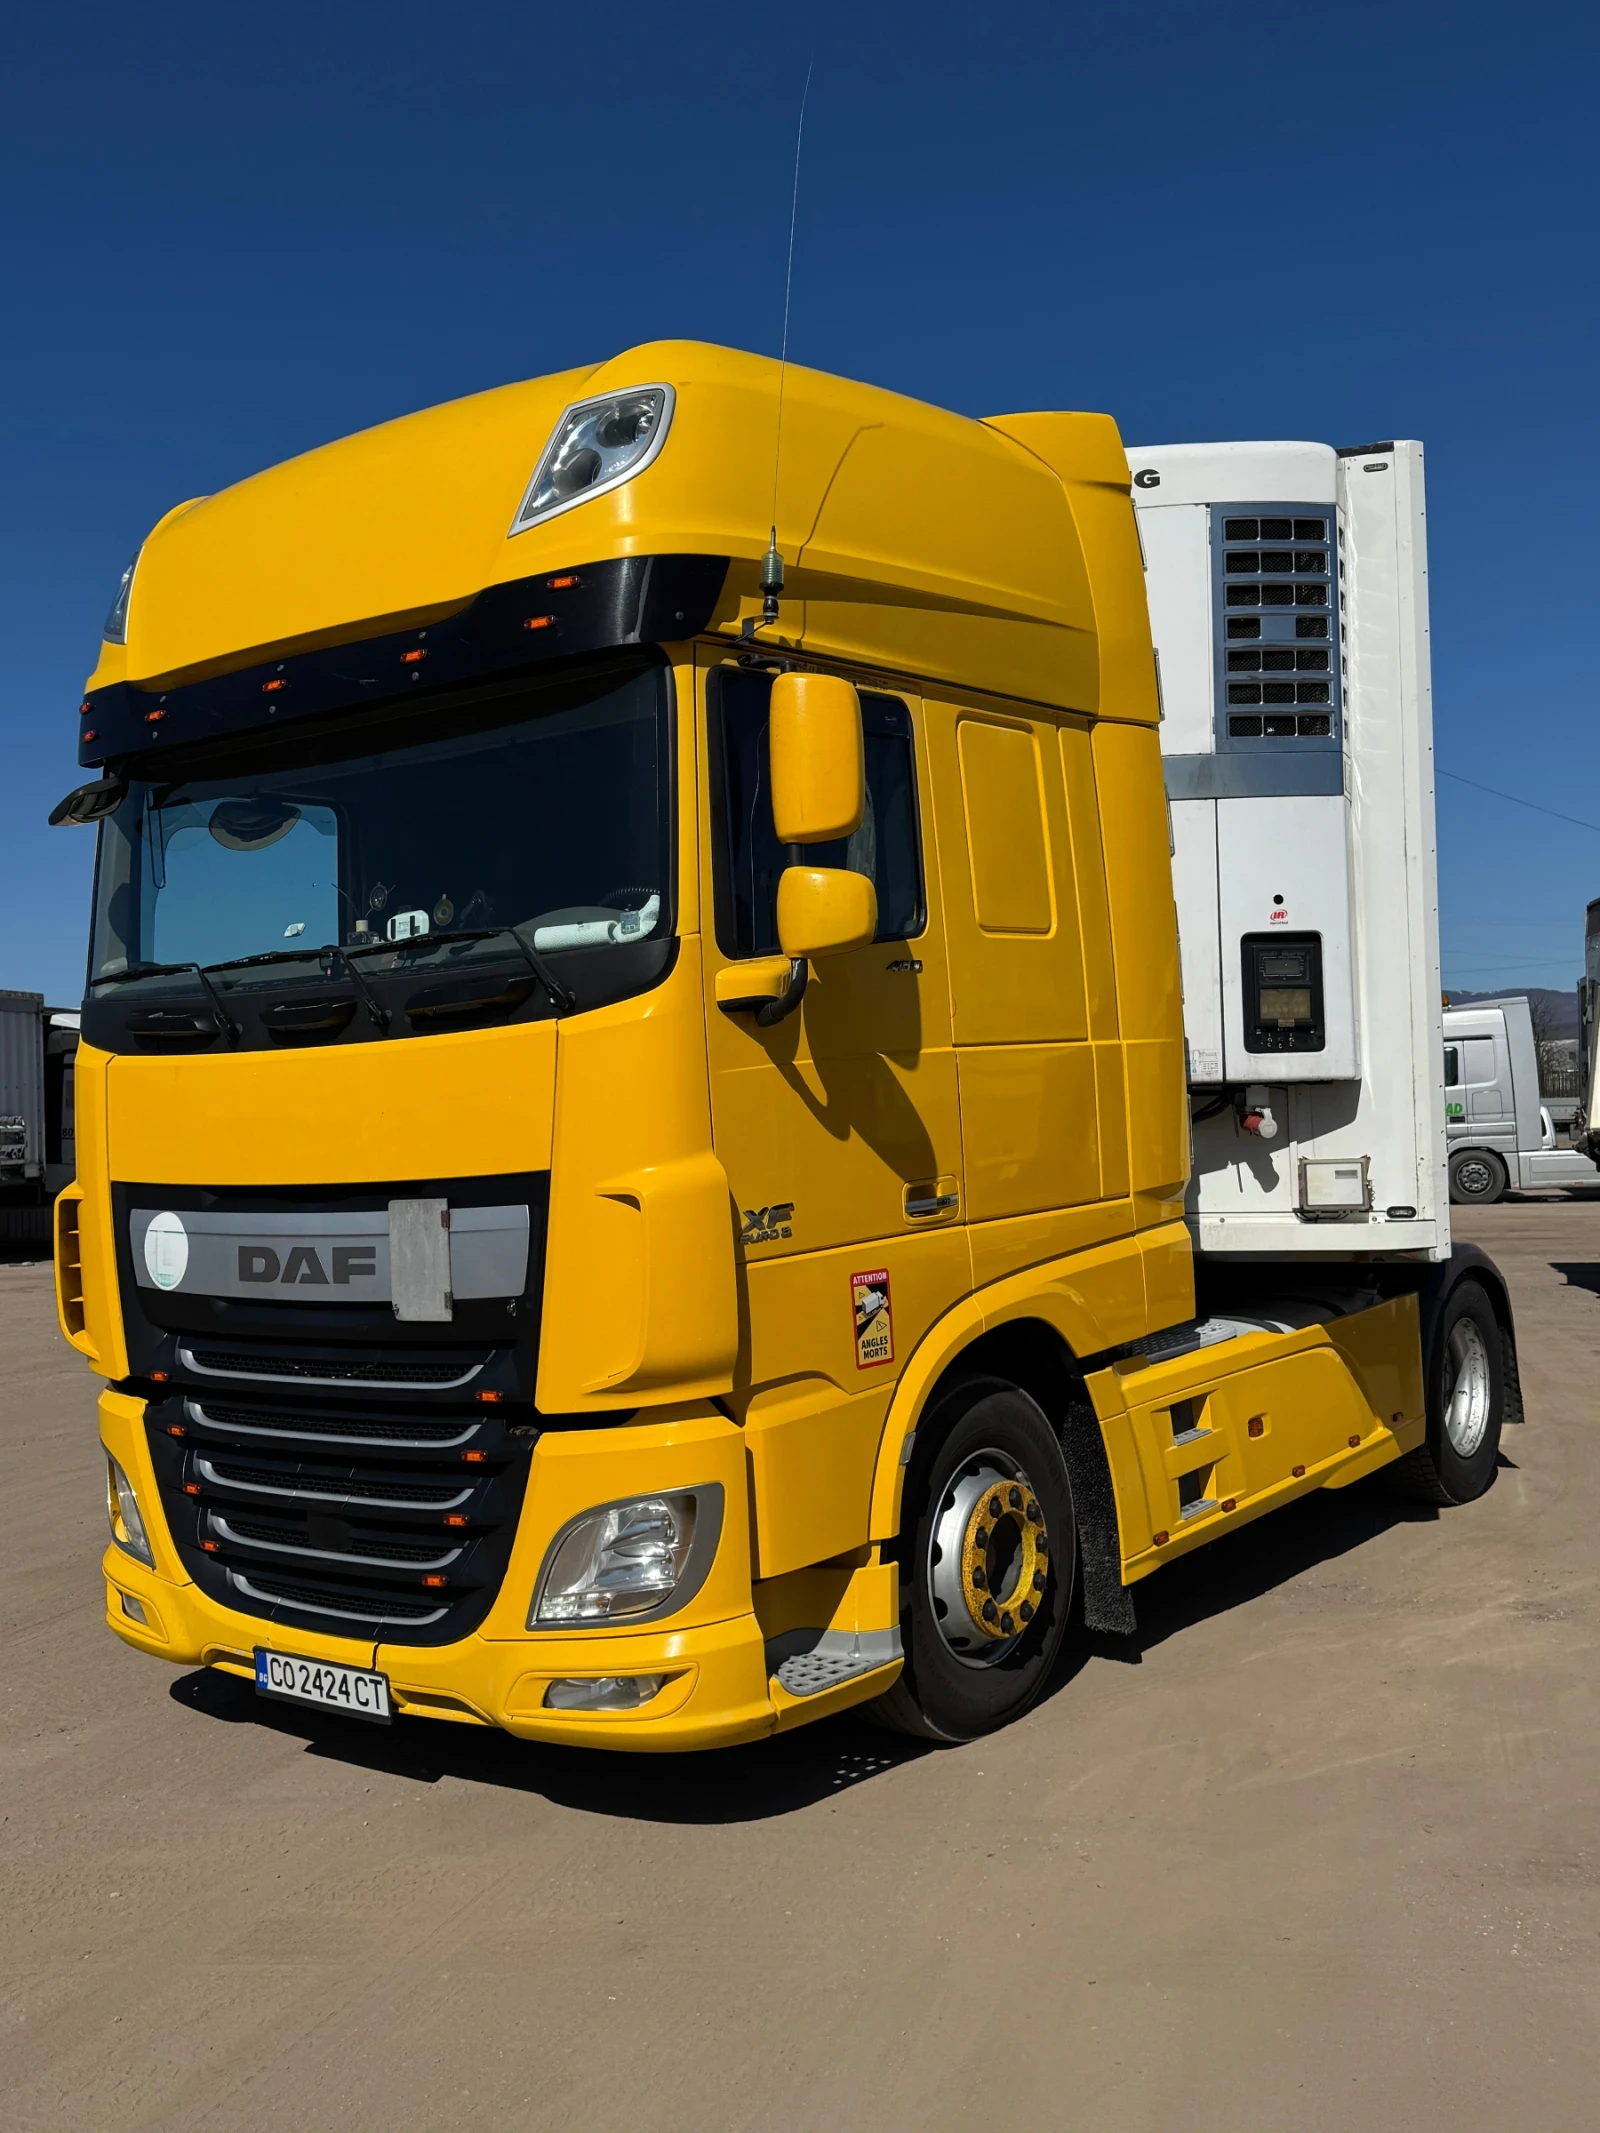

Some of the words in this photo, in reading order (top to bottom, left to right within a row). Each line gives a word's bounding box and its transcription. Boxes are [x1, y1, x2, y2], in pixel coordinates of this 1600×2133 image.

[742, 1202, 795, 1233] XF
[739, 1228, 779, 1245] EURO
[238, 1245, 377, 1285] DAF
[853, 1272, 888, 1285] ATTENTION
[861, 1335, 888, 1350] ANGLES
[863, 1347, 888, 1360] MORTS
[258, 1672, 268, 1683] BG
[270, 1657, 296, 1690] CO
[298, 1665, 351, 1703] 2424
[354, 1676, 383, 1709] CT
